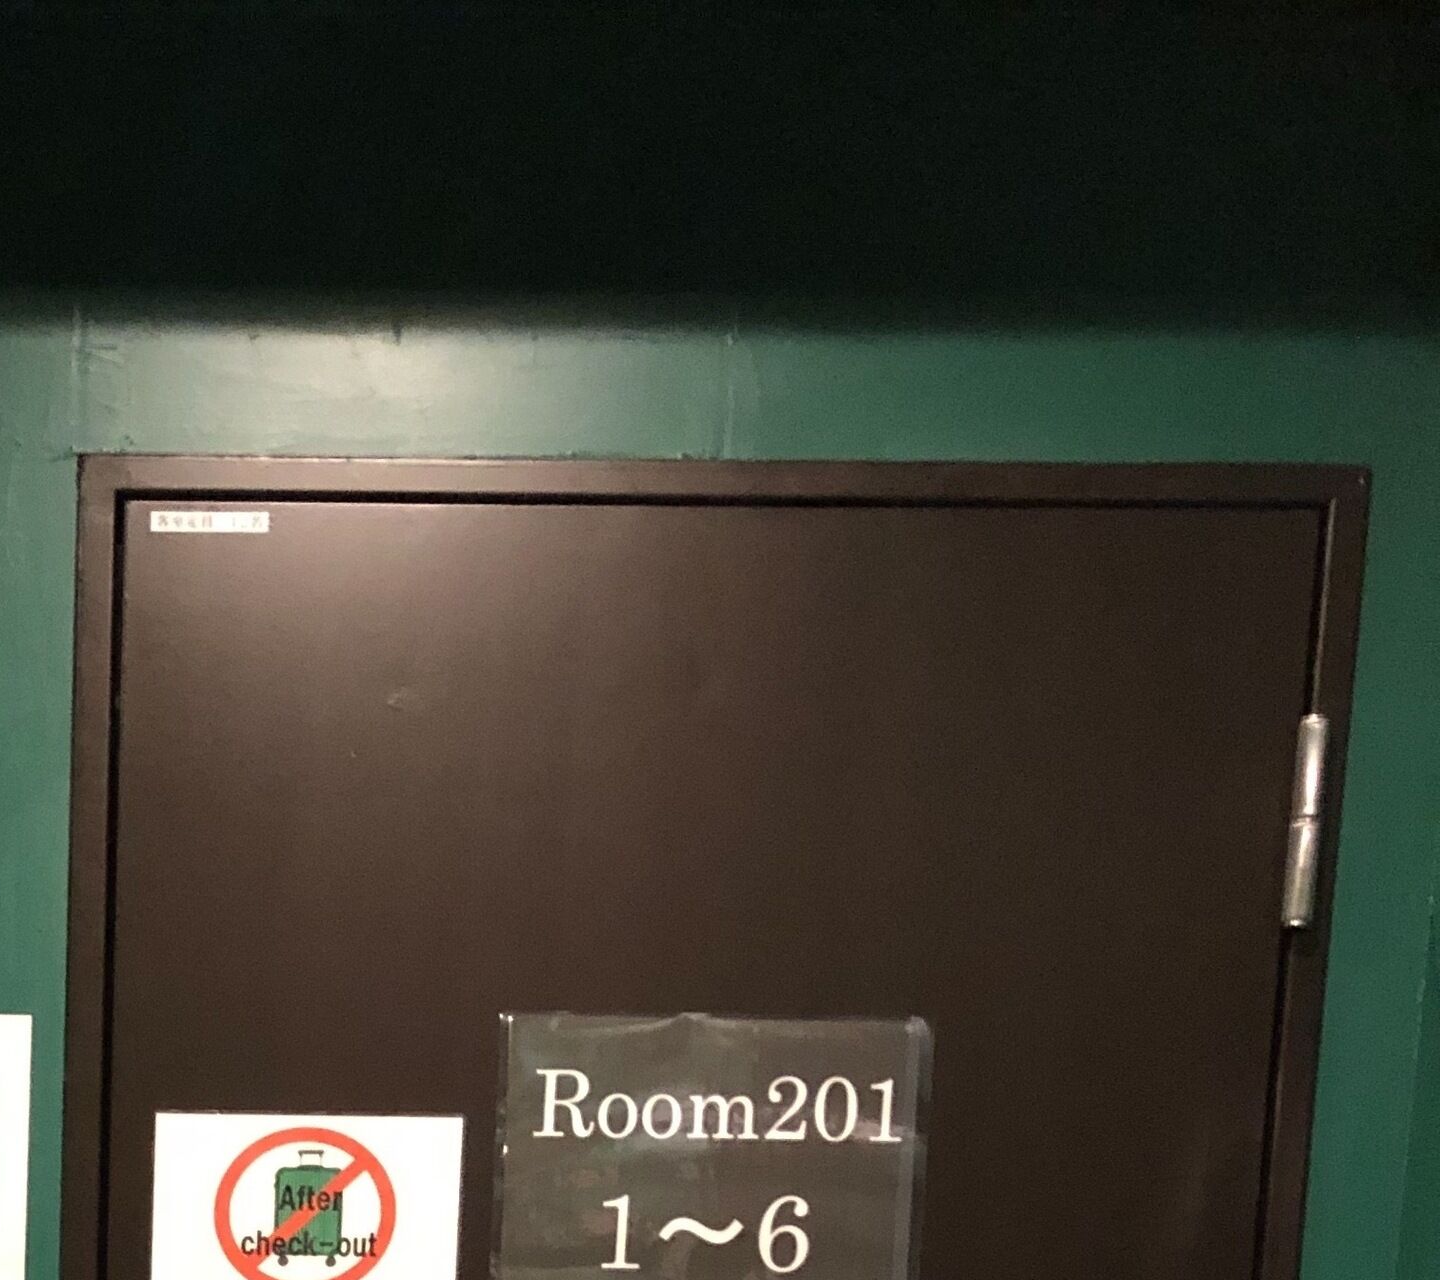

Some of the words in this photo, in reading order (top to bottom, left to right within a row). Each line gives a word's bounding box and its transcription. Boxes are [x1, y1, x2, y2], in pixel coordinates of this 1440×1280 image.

[532, 1067, 902, 1143] Room201
[278, 1184, 343, 1212] After
[240, 1230, 378, 1259] check-out
